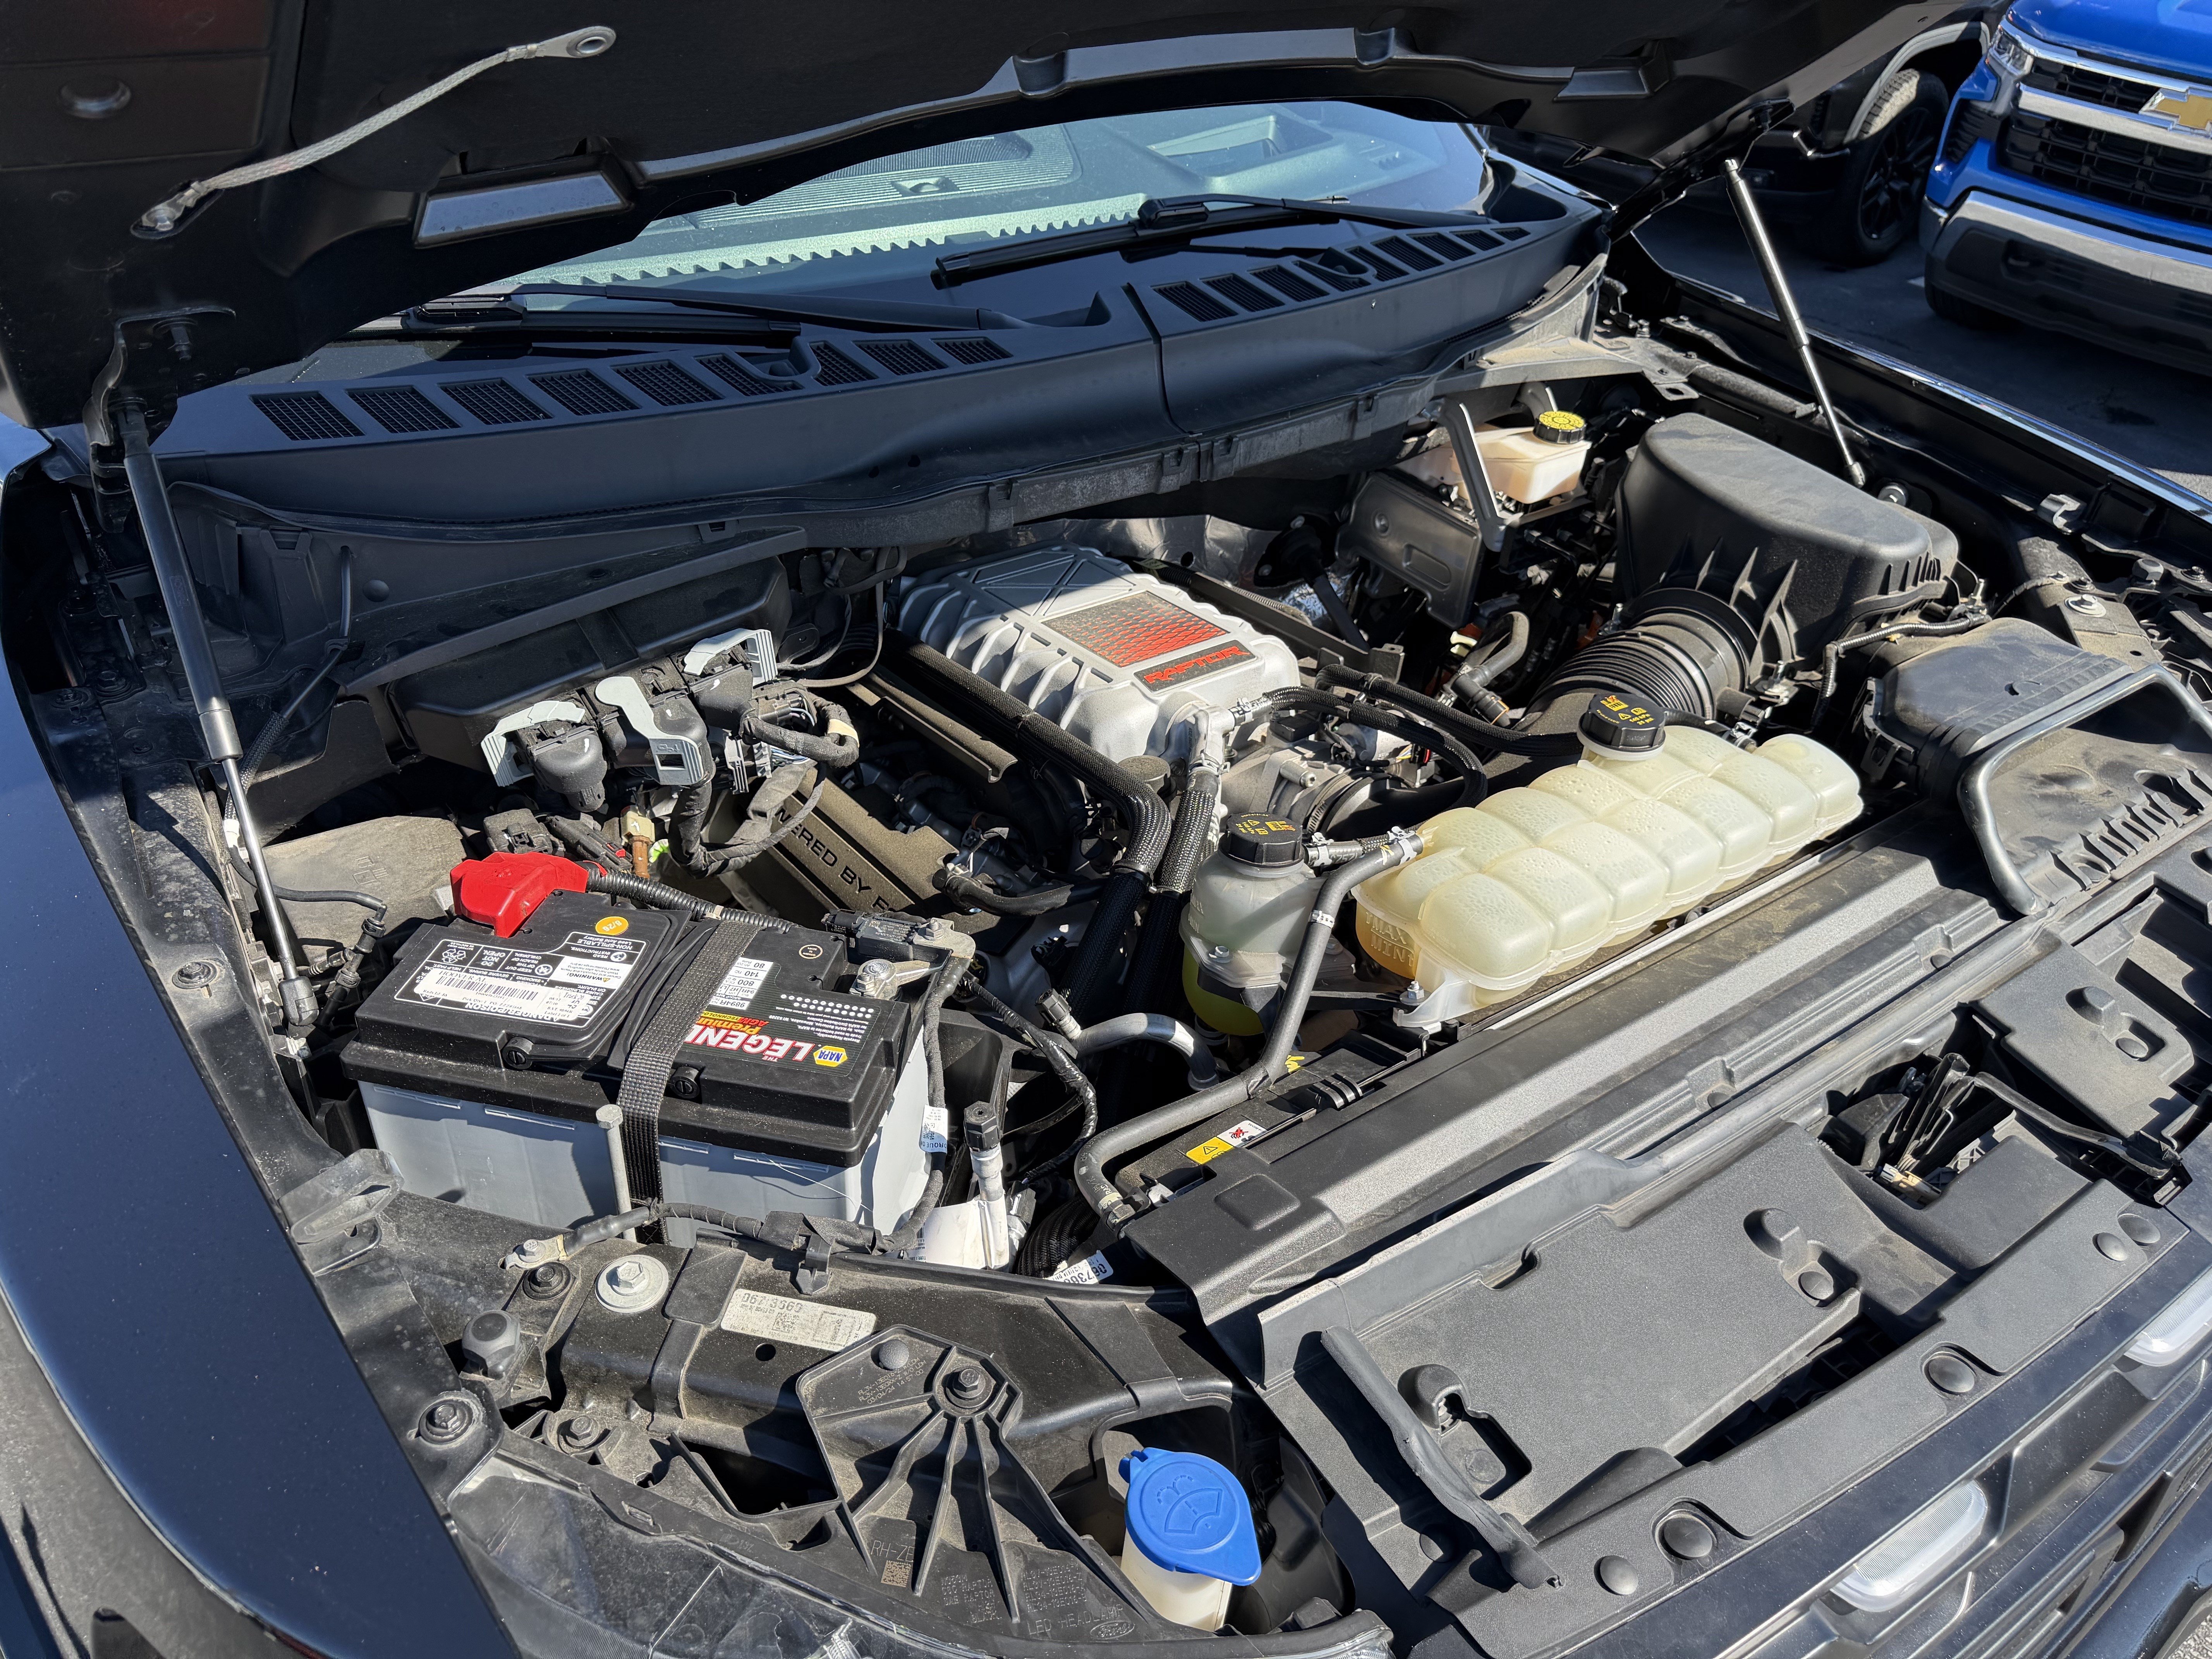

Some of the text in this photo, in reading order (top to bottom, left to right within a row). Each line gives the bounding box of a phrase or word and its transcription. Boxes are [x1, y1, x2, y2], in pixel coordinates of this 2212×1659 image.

[1144, 645, 1250, 685] RAPTOR
[839, 866, 872, 893] BY
[1372, 920, 1407, 944] MAX
[577, 939, 633, 950] NON-SPILLABLE
[1371, 936, 1405, 960] MIN
[567, 972, 602, 981] WARNING!
[697, 1016, 762, 1035] Premiu
[738, 1017, 769, 1027] AGM
[818, 1050, 843, 1063] NAPA
[1027, 1618, 1052, 1635] LED
